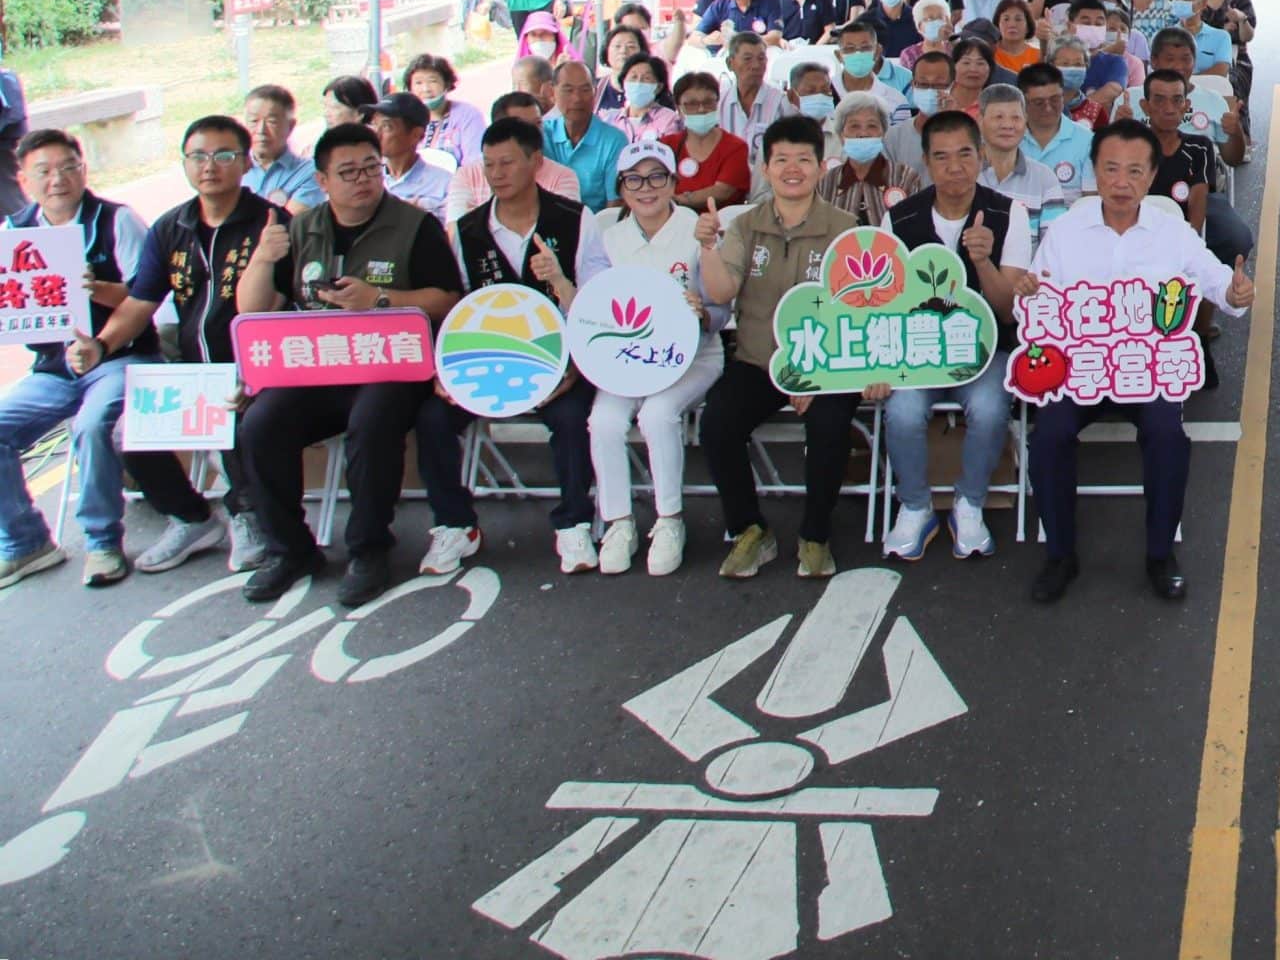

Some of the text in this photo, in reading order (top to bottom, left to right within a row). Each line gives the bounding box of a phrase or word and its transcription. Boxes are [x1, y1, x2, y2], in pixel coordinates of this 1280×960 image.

[0, 240, 48, 274] 瓜
[1021, 279, 1154, 340] 食在地
[789, 312, 980, 372] 水上鄉農會
[1066, 338, 1200, 399] 享當季
[181, 392, 227, 436] UP
